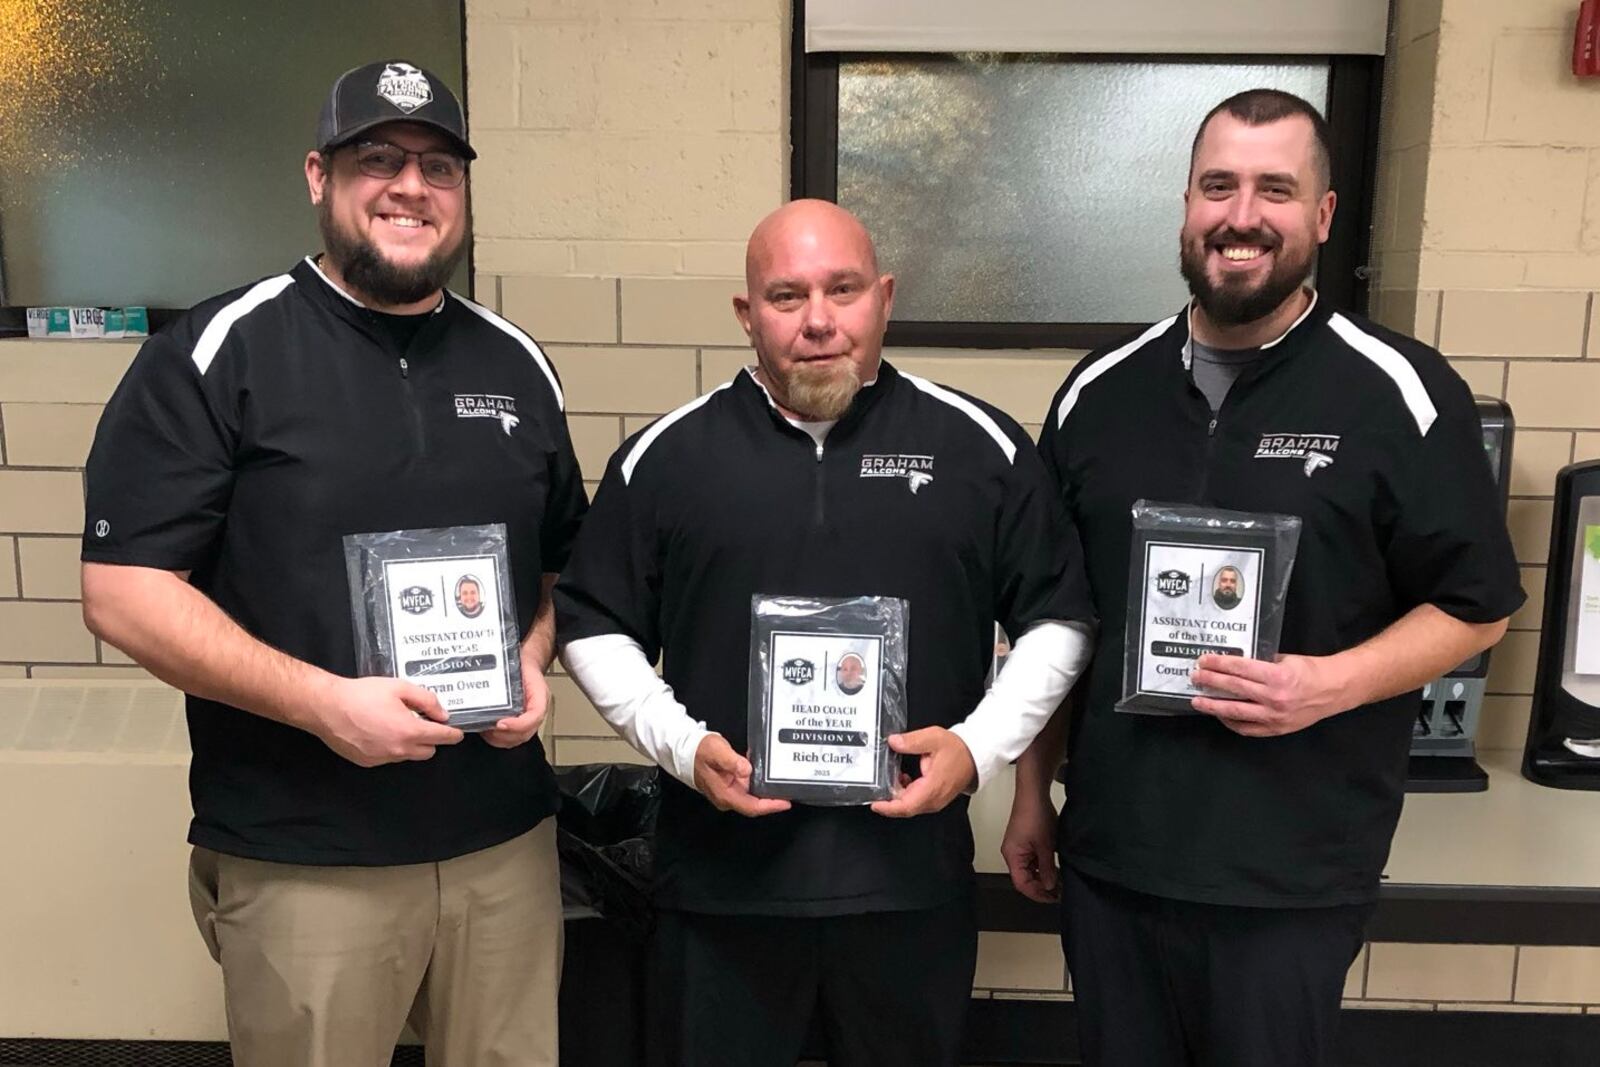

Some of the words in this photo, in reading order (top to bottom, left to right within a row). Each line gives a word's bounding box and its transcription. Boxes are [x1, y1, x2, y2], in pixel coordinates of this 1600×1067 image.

[73, 309, 104, 325] VERGE
[455, 398, 516, 412] GRAHAM
[1260, 438, 1339, 451] GRAHAM
[861, 458, 934, 470] GRAHAM
[1159, 578, 1187, 591] MVFCA
[402, 595, 432, 607] MVFCA
[1152, 616, 1207, 629] ASSISTANT
[1210, 620, 1247, 632] COACH
[403, 632, 457, 645] ASSISTANT
[1169, 630, 1179, 640] of
[1181, 631, 1197, 641] the
[1199, 633, 1227, 644] YEAR
[421, 646, 432, 657] of
[433, 645, 449, 655] the
[784, 666, 812, 678] MVFCA
[1156, 664, 1189, 676] Court
[456, 680, 490, 691] Owen
[792, 704, 820, 714] HEAD
[822, 705, 857, 715] COACH
[795, 717, 806, 727] of
[808, 718, 824, 727] the
[825, 718, 852, 728] YEAR
[792, 732, 843, 742] DIVISION
[793, 752, 819, 763] Rich
[821, 753, 853, 764] Clark
